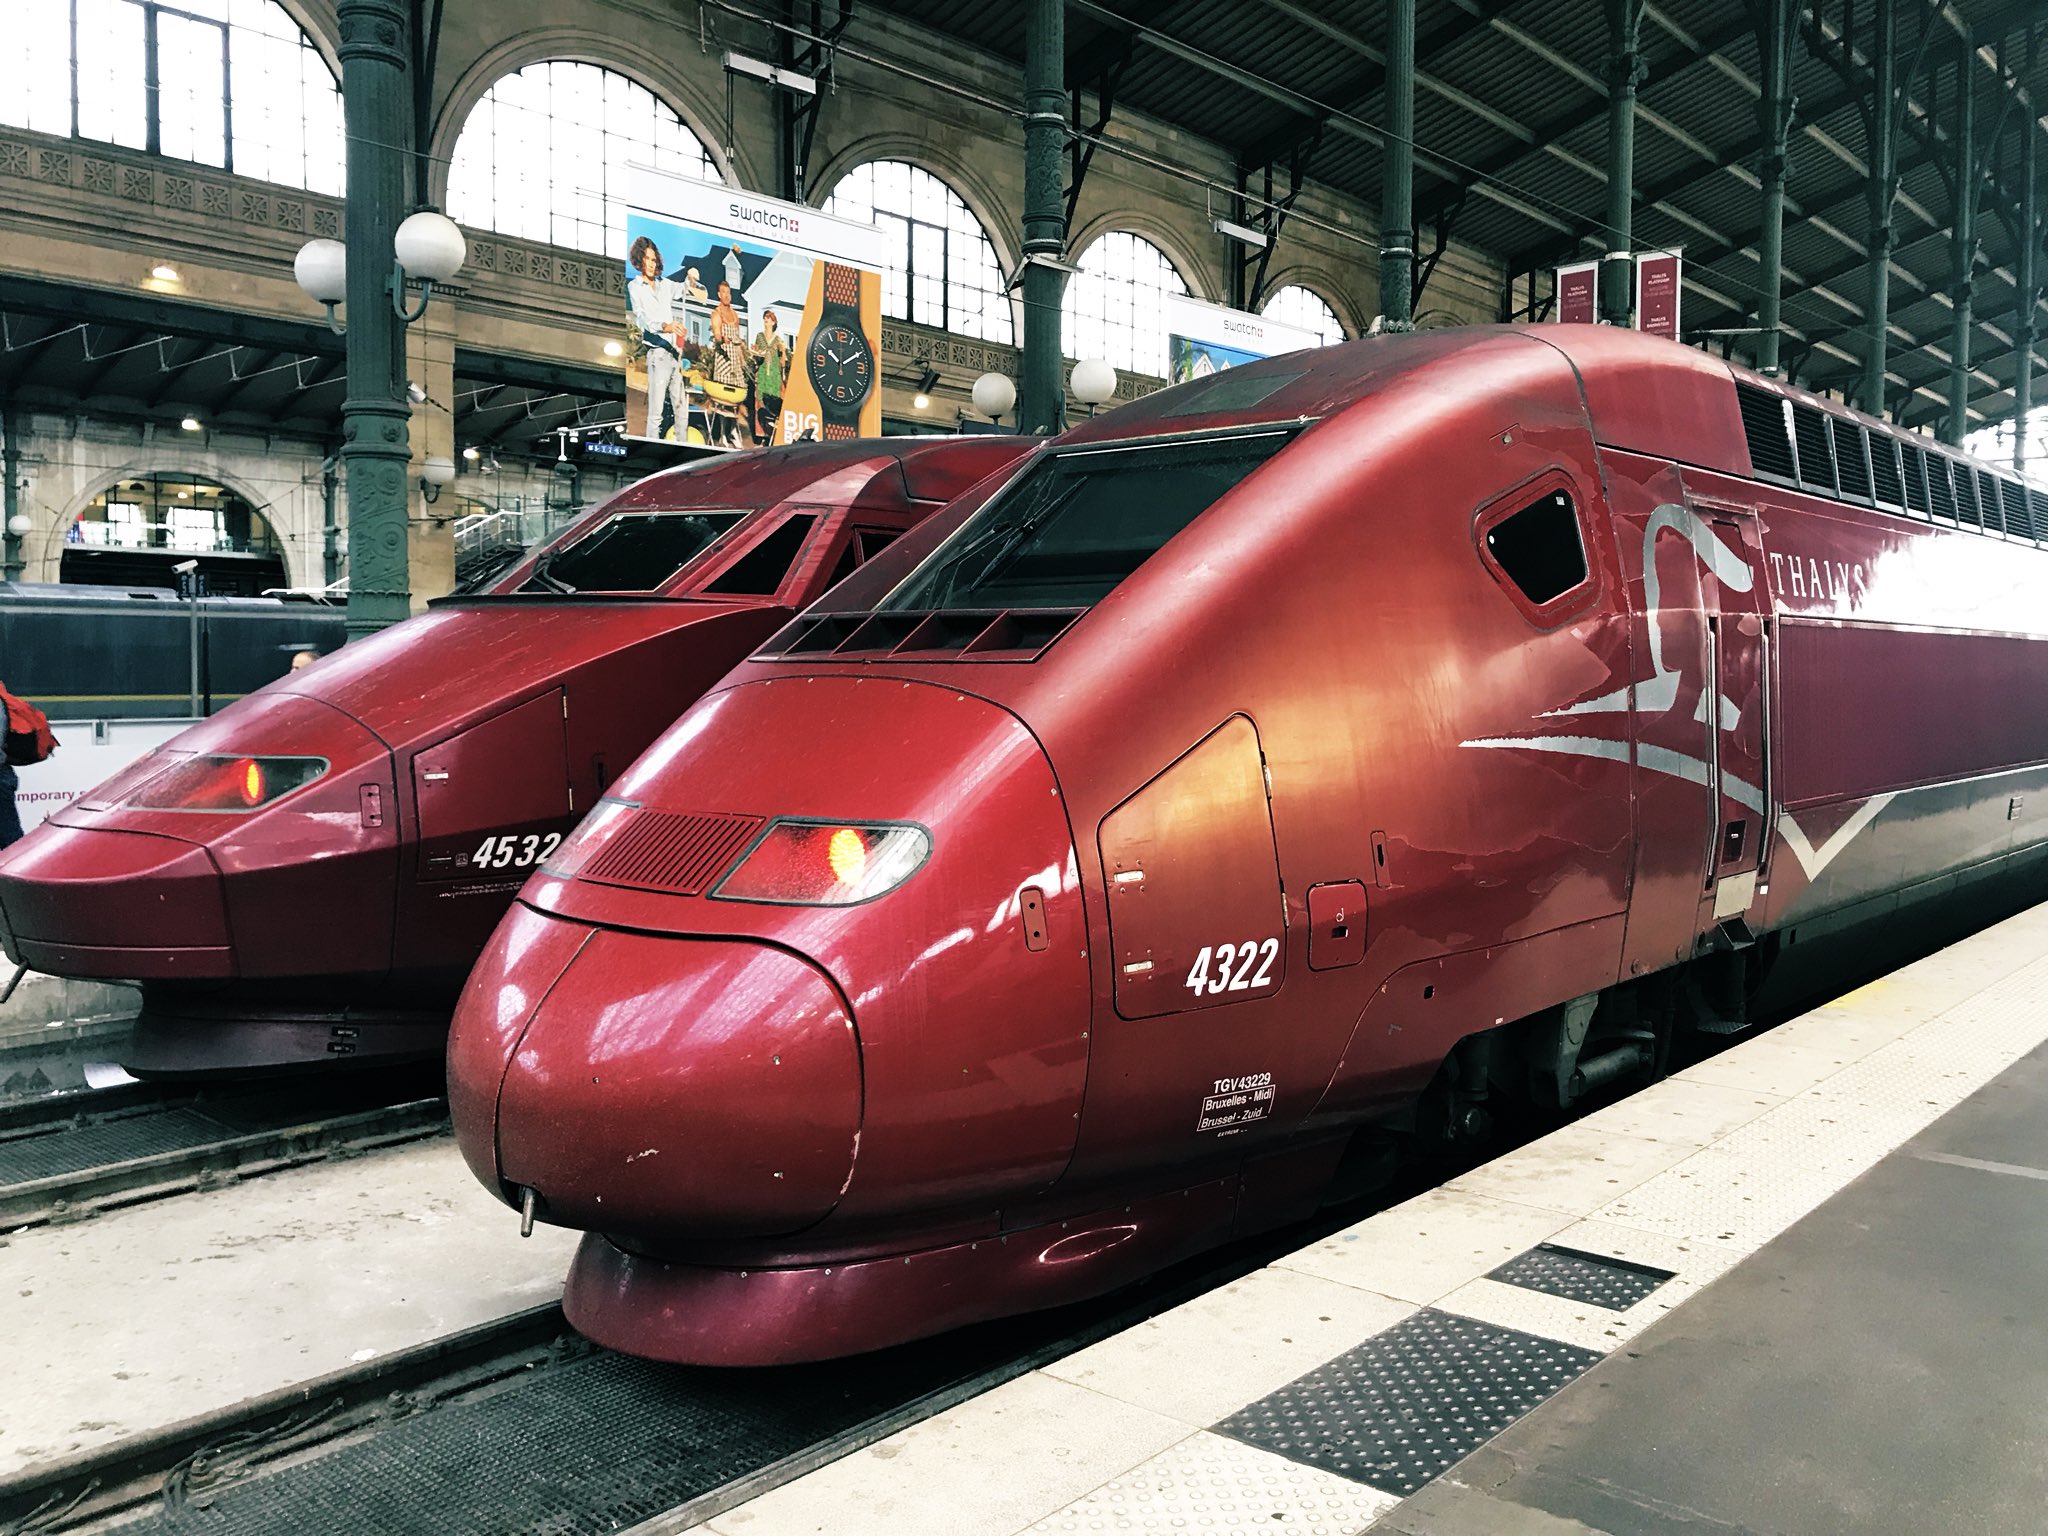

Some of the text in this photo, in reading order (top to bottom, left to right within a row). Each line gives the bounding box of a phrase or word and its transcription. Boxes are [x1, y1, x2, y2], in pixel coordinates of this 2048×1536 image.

[730, 204, 788, 230] swatch
[1223, 319, 1257, 336] swatch
[856, 362, 865, 374] 3
[837, 386, 845, 398] 6
[784, 410, 819, 434] BIG
[1769, 552, 1867, 600] THALYS
[17, 791, 75, 803] mporary
[472, 833, 562, 869] 4532
[1185, 938, 1279, 997] 4322
[1213, 1072, 1271, 1094] TGV43229
[1205, 1094, 1247, 1111] Bruxelles
[1253, 1088, 1273, 1102] Midi
[1201, 1112, 1237, 1128] Brussel
[1241, 1107, 1263, 1120] Zuid
